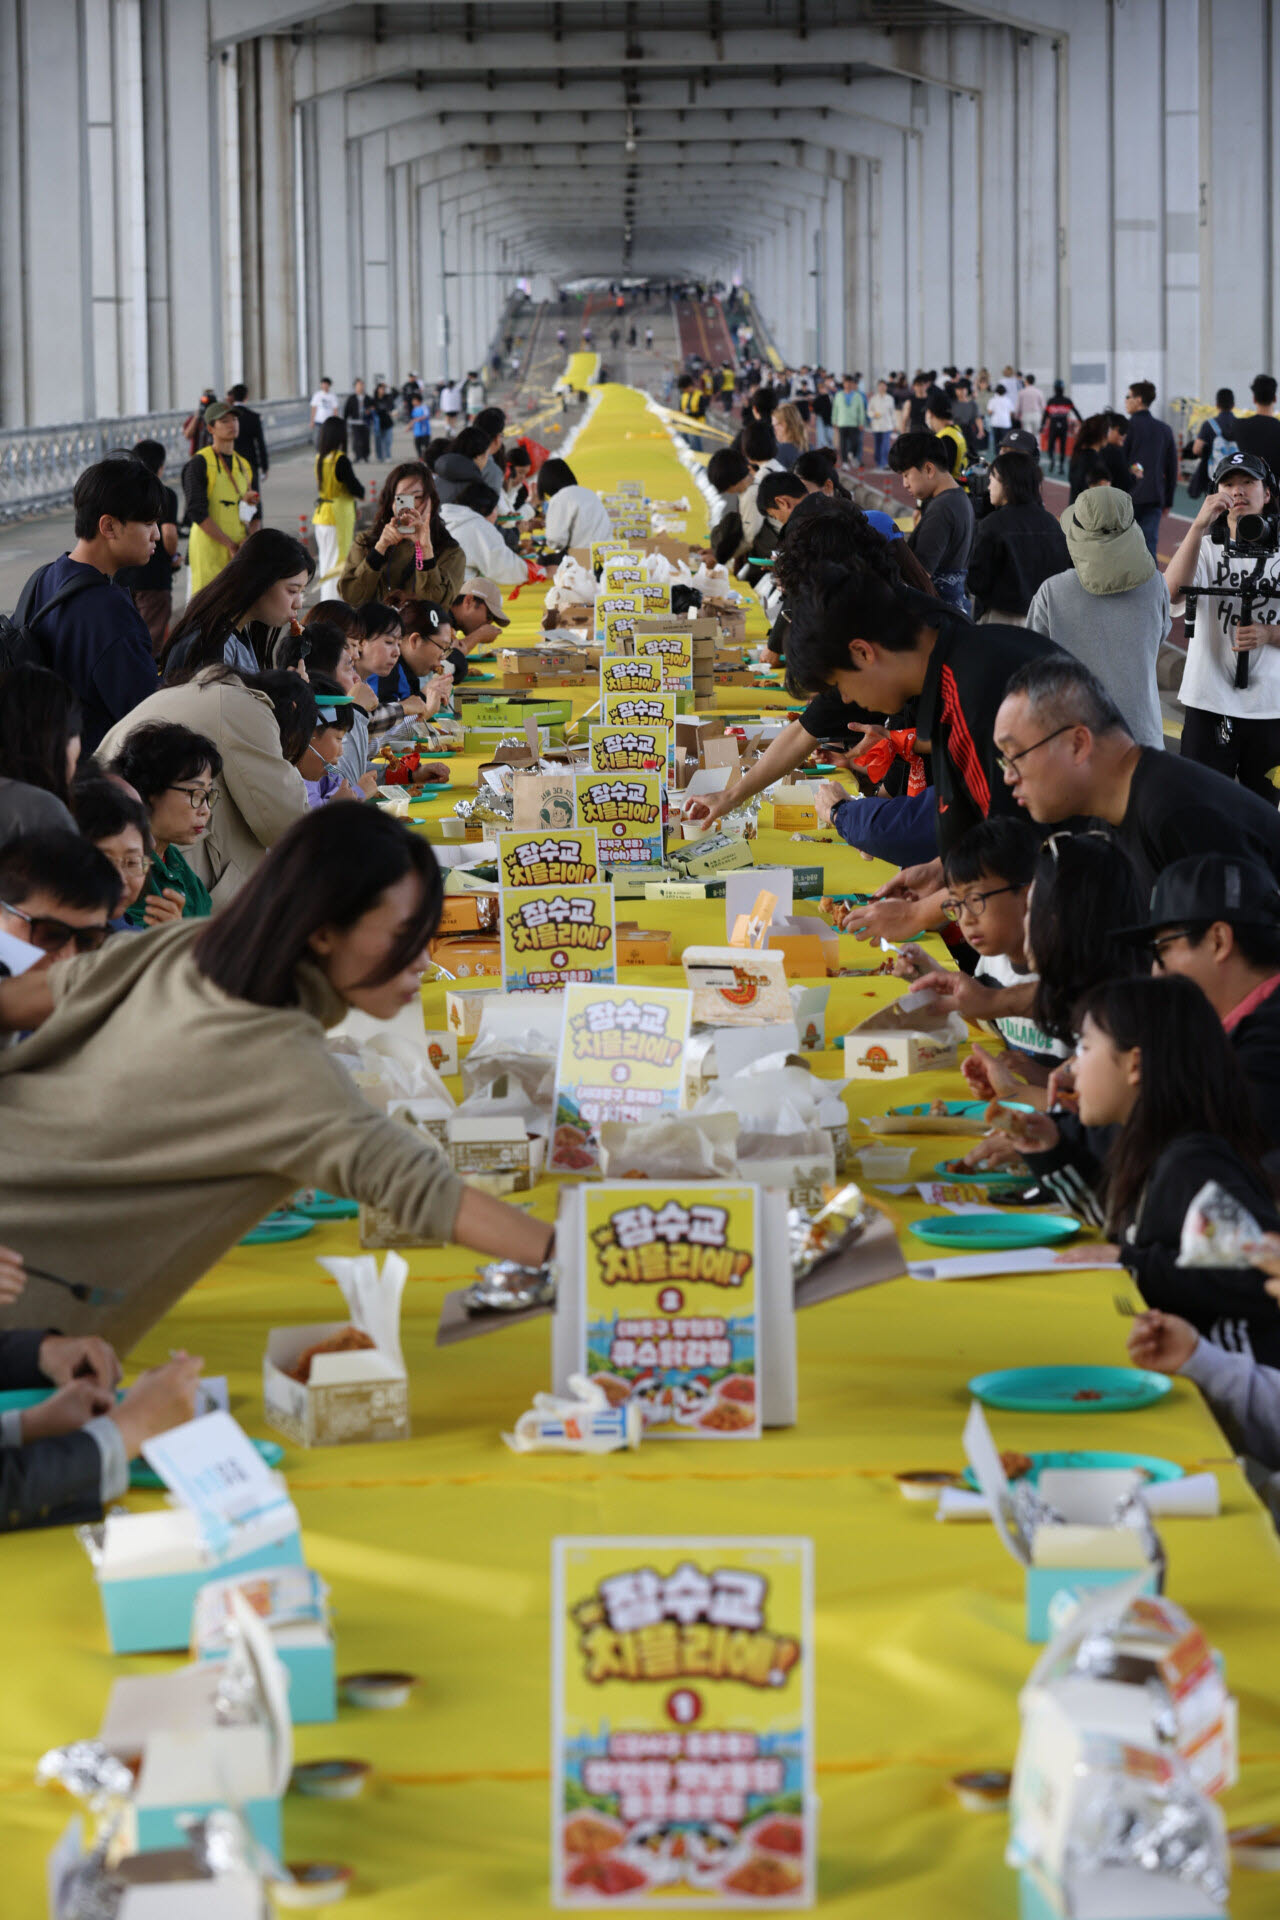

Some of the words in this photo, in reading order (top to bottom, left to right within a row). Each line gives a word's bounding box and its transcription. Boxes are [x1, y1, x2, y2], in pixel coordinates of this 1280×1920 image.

[1231, 453, 1244, 464] S
[644, 638, 683, 655] 잠수교
[611, 662, 652, 679] 잠수교
[606, 676, 661, 692] 치믈리에!
[617, 699, 664, 718] 잠수교
[603, 732, 655, 753] 잠수교
[589, 781, 647, 804] 잠수교
[583, 801, 659, 823] 치믈리에!
[613, 823, 625, 835] 6
[515, 838, 581, 866] 잠수교
[508, 861, 596, 886] 치믈리에!
[520, 896, 595, 928] 잠수교
[513, 922, 611, 951] 치믈리에!
[552, 952, 567, 967] 4
[585, 998, 669, 1036] 잠수교
[573, 1029, 681, 1067] 치믈리에!
[610, 1200, 729, 1248] 잠수교
